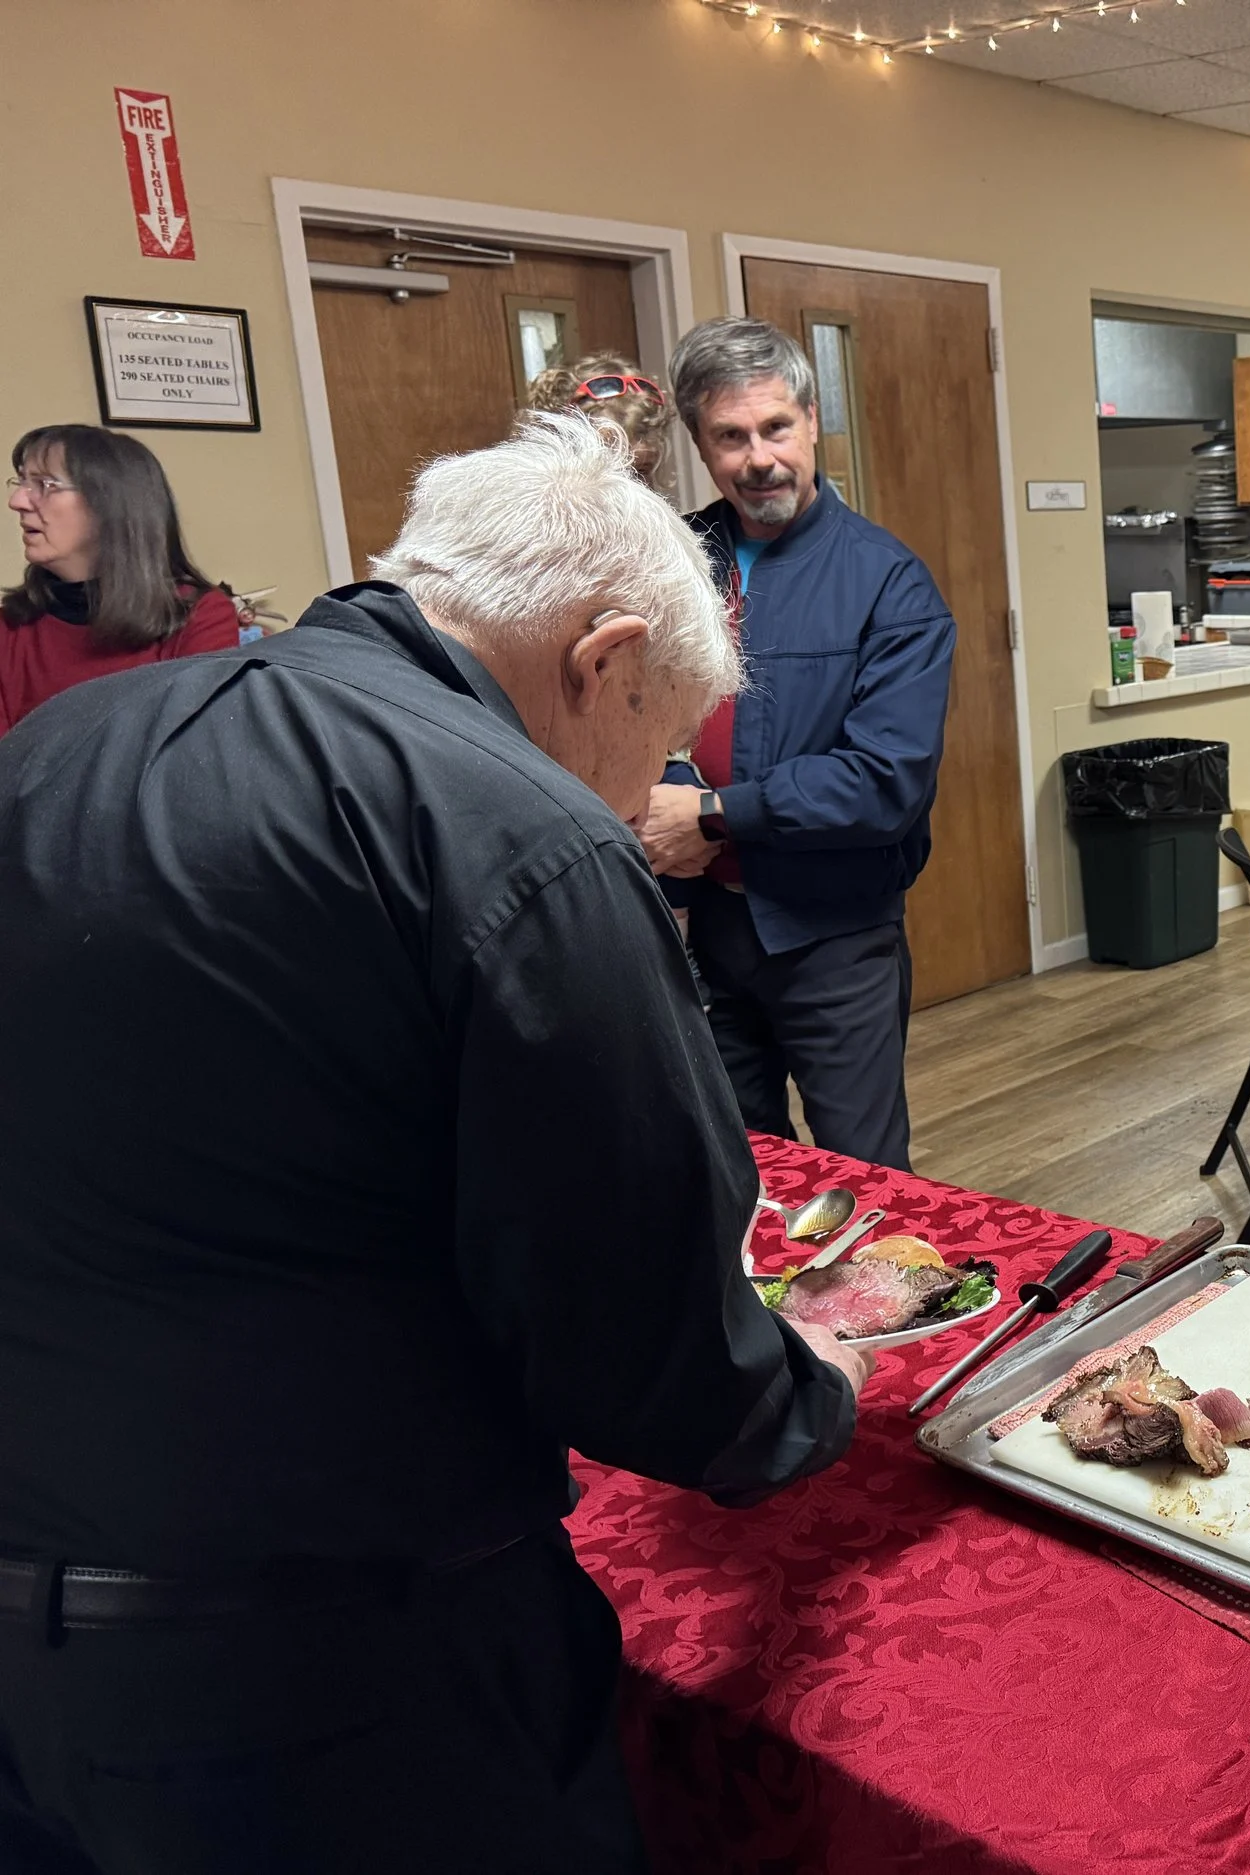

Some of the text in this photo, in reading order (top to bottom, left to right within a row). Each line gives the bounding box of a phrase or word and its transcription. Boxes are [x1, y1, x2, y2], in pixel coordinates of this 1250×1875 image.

[127, 105, 166, 131] FIRE
[145, 133, 172, 243] EXTINGUISHER
[127, 331, 214, 345] OCCUPANCY LOAD
[119, 354, 230, 370] 135 SEATED TABLES
[120, 371, 231, 387] 290 SEATED CHAIRS
[162, 388, 194, 399] ONLY
